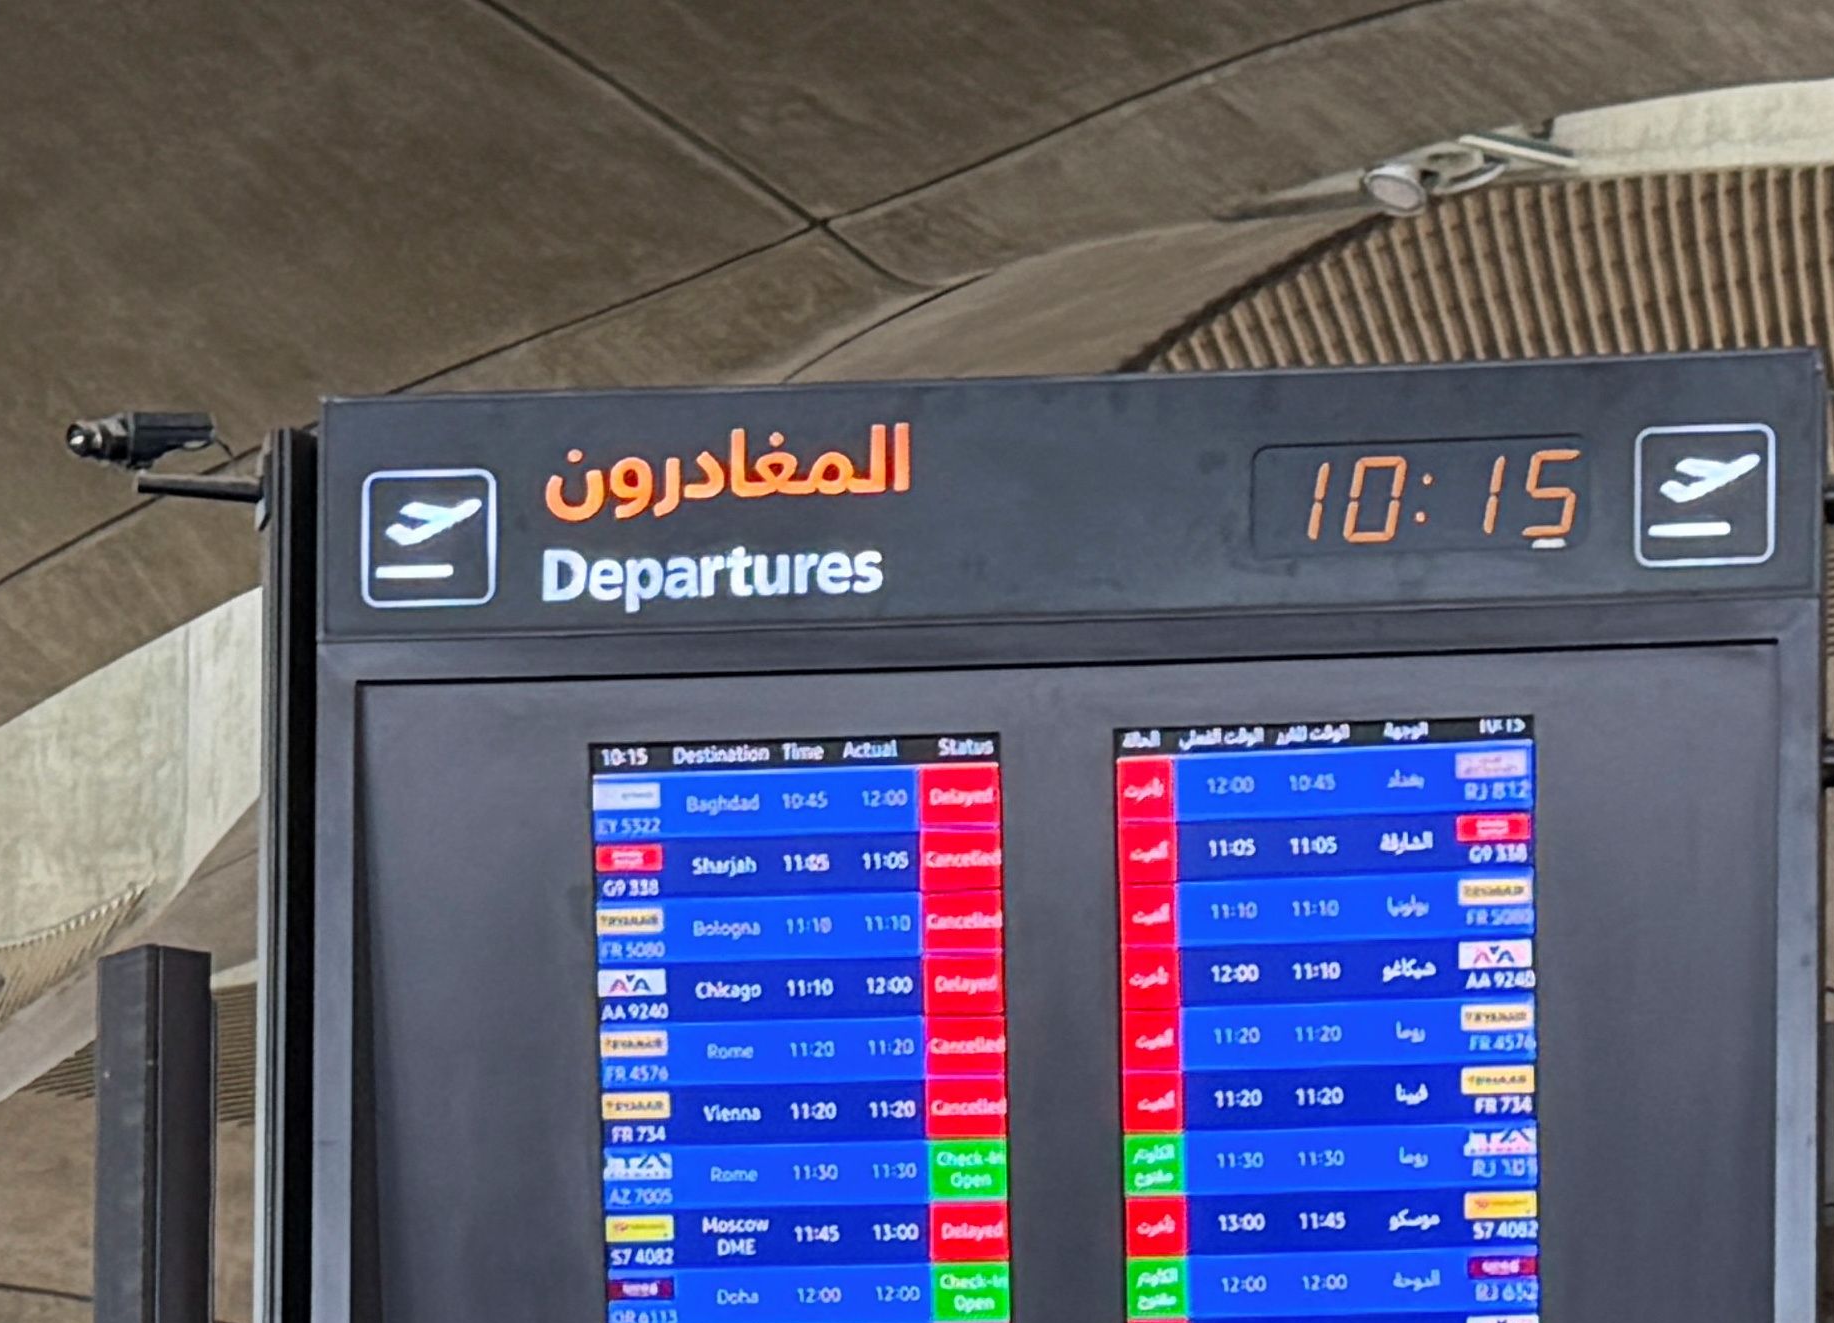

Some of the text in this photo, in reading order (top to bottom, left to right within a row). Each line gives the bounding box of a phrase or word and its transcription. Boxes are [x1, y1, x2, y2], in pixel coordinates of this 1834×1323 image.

[544, 423, 909, 523] المغادرون
[1306, 451, 1582, 543] 10:15
[542, 545, 884, 613] Departures
[601, 737, 995, 767] 10:15 Destination Time Actual Status
[686, 793, 760, 816] Baghdad
[782, 790, 829, 810] 10:45
[862, 788, 908, 807] 12:00
[691, 855, 757, 878] Sharjah
[783, 853, 830, 872] 11:05
[862, 850, 910, 870] 11:05
[693, 920, 761, 940] Bologna
[786, 916, 833, 934] 11:10
[864, 914, 912, 932] 11:10
[695, 981, 762, 1002] Chicago
[786, 977, 834, 997] 11:10
[866, 975, 914, 995] 12:00
[706, 1043, 754, 1060] Rome
[790, 1040, 835, 1058] 11:20
[868, 1038, 915, 1056] 11:20
[703, 1099, 917, 1122] Vienna 11:20 11:20
[710, 1162, 918, 1182] Rome 11:30 11:30
[701, 1216, 770, 1234] Moscow
[794, 1224, 840, 1243] 11:45
[873, 1222, 920, 1242] 13:00
[717, 1237, 756, 1257] DME
[716, 1285, 921, 1305] Doha 12:00 12:00
